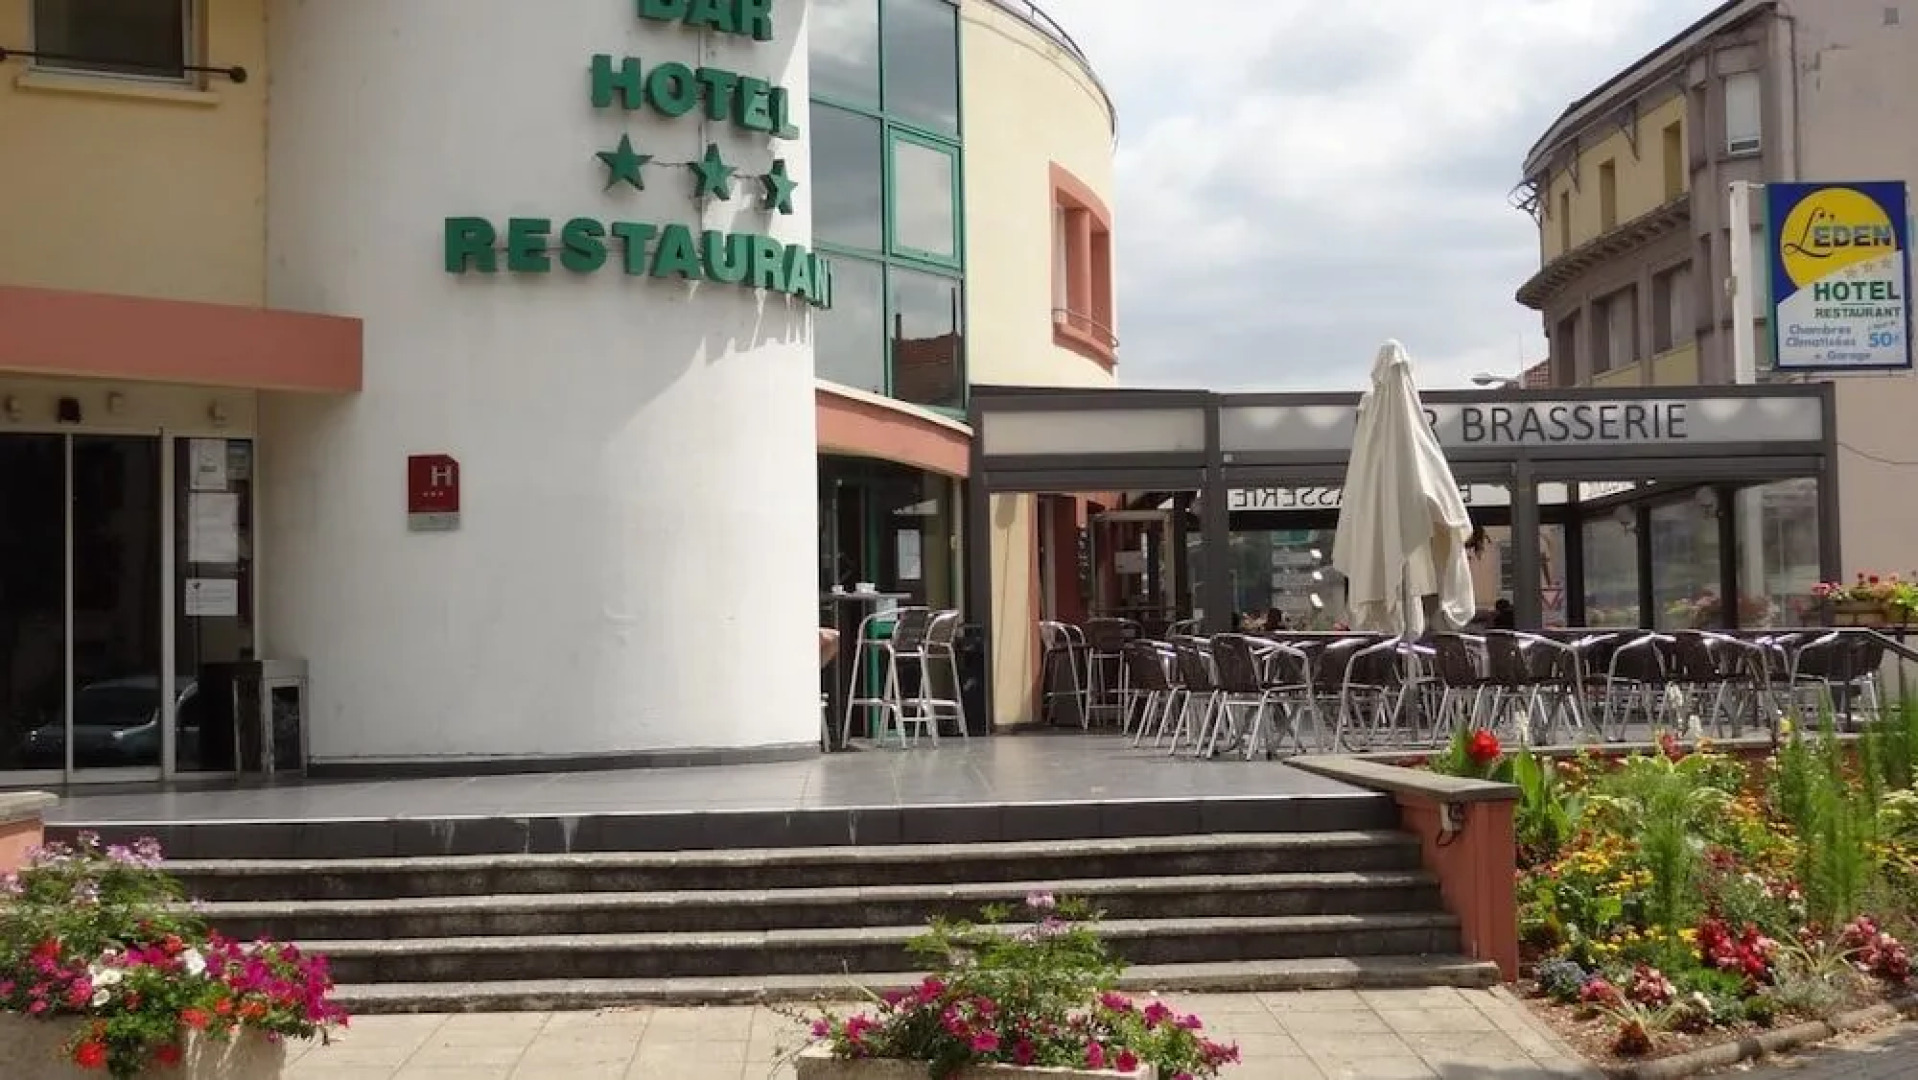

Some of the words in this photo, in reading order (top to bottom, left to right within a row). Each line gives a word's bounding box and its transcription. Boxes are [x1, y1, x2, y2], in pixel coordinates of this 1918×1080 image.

[591, 53, 800, 140] HOTEL
[1814, 281, 1901, 302] HOTEL
[1815, 307, 1901, 319] RESTAURANT
[1789, 324, 1852, 335] Chambres
[1461, 404, 1688, 443] BRASSERIE
[431, 465, 453, 487] H
